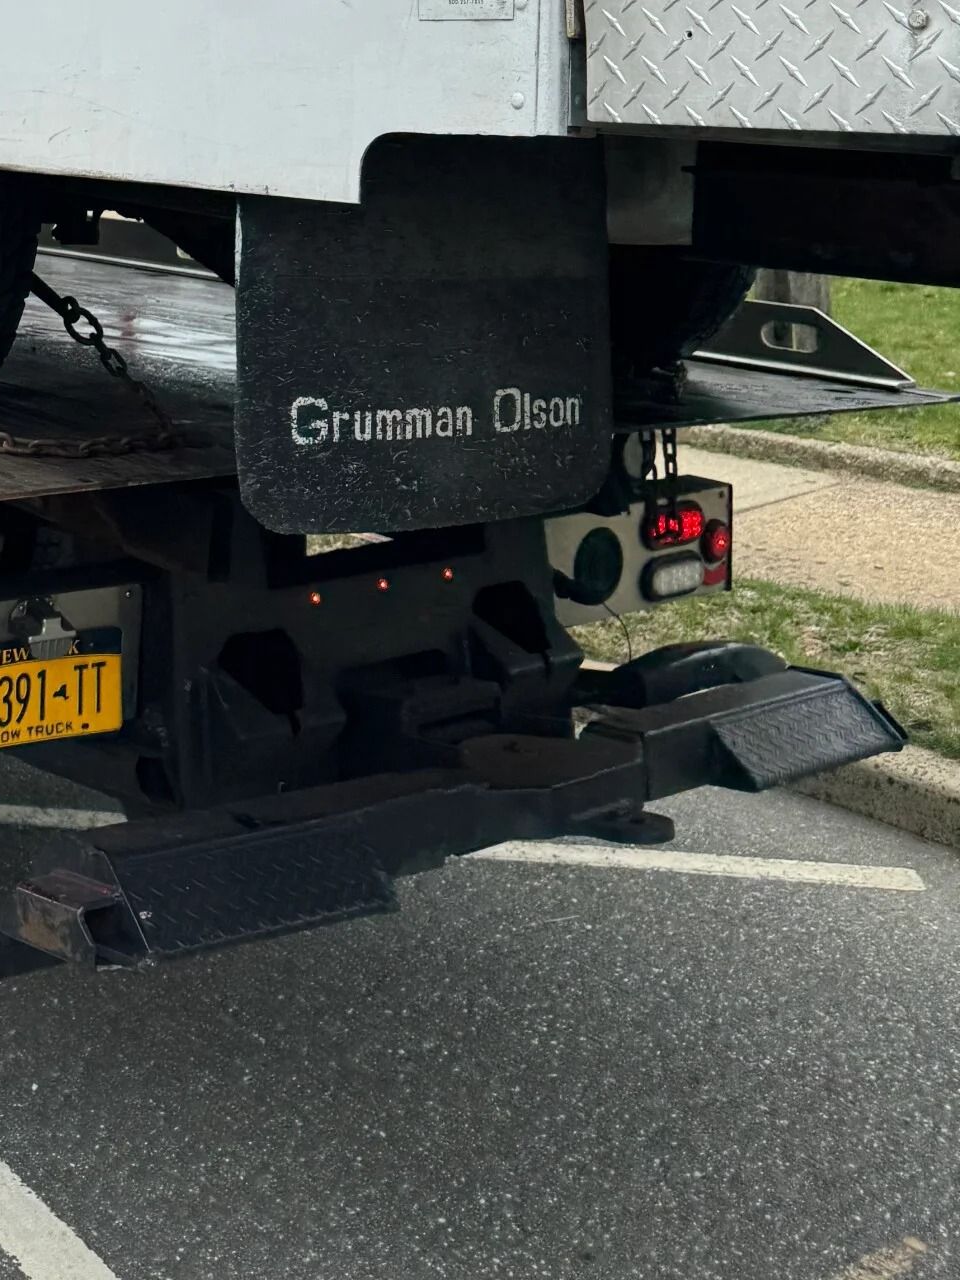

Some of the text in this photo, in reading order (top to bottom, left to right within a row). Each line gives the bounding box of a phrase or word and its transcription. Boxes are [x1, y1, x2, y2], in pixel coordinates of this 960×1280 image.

[290, 387, 583, 445] Grumman Olson
[74, 660, 107, 716] TT
[27, 721, 74, 738] TRUCK
